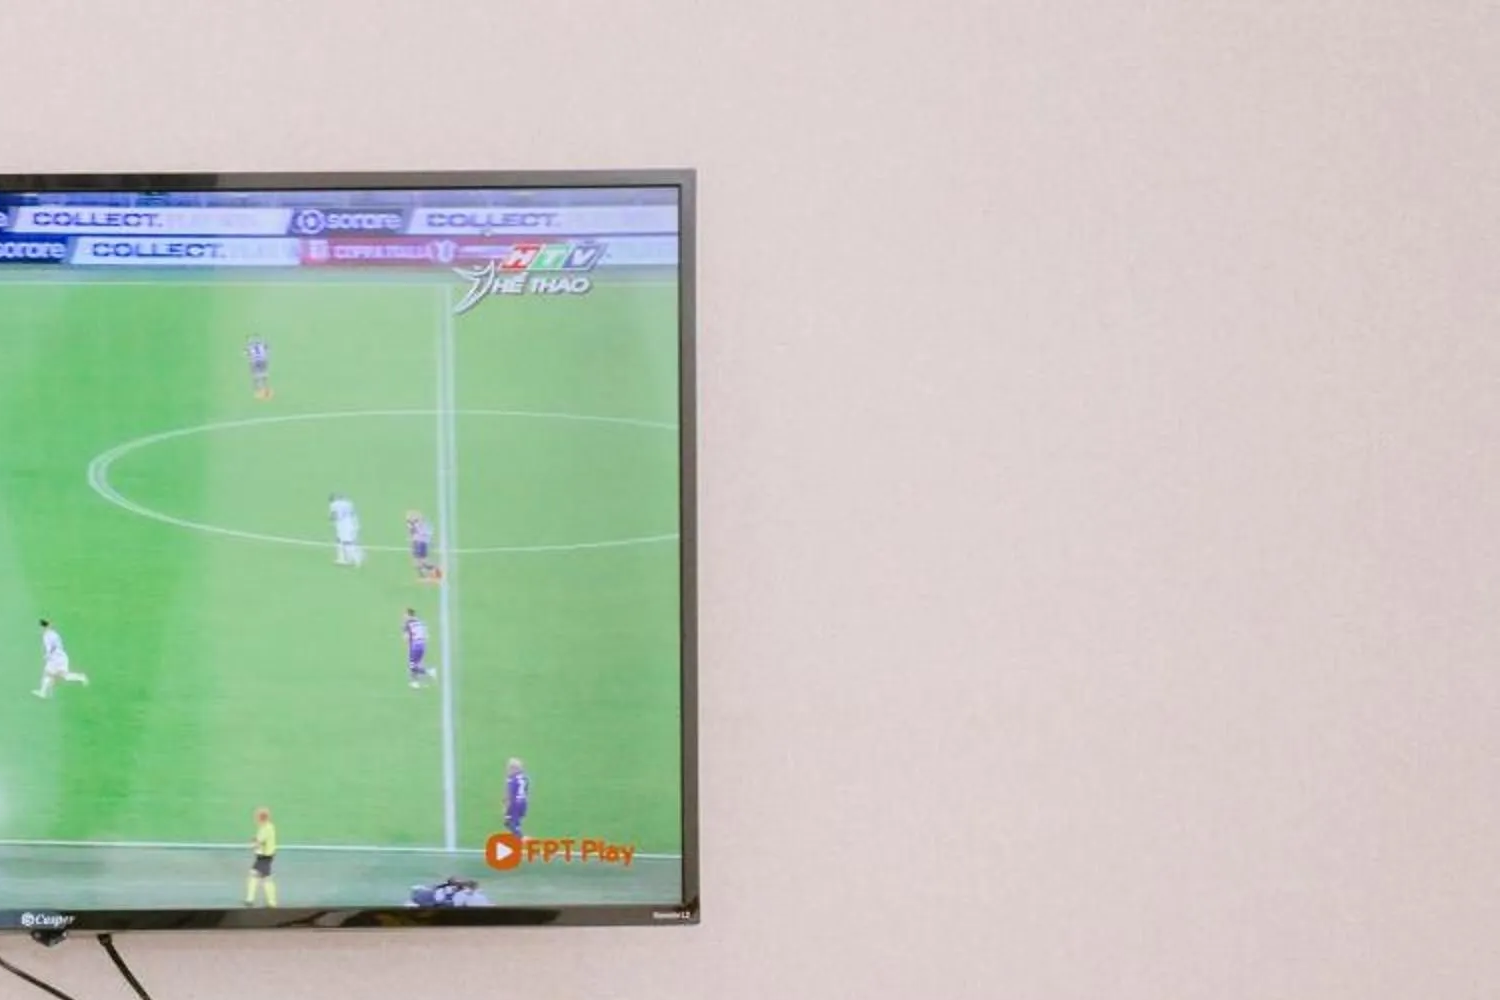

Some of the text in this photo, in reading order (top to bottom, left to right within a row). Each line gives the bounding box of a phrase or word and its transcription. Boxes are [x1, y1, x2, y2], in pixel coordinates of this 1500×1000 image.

[501, 246, 600, 269] HTV
[526, 838, 635, 866] FPT Play
